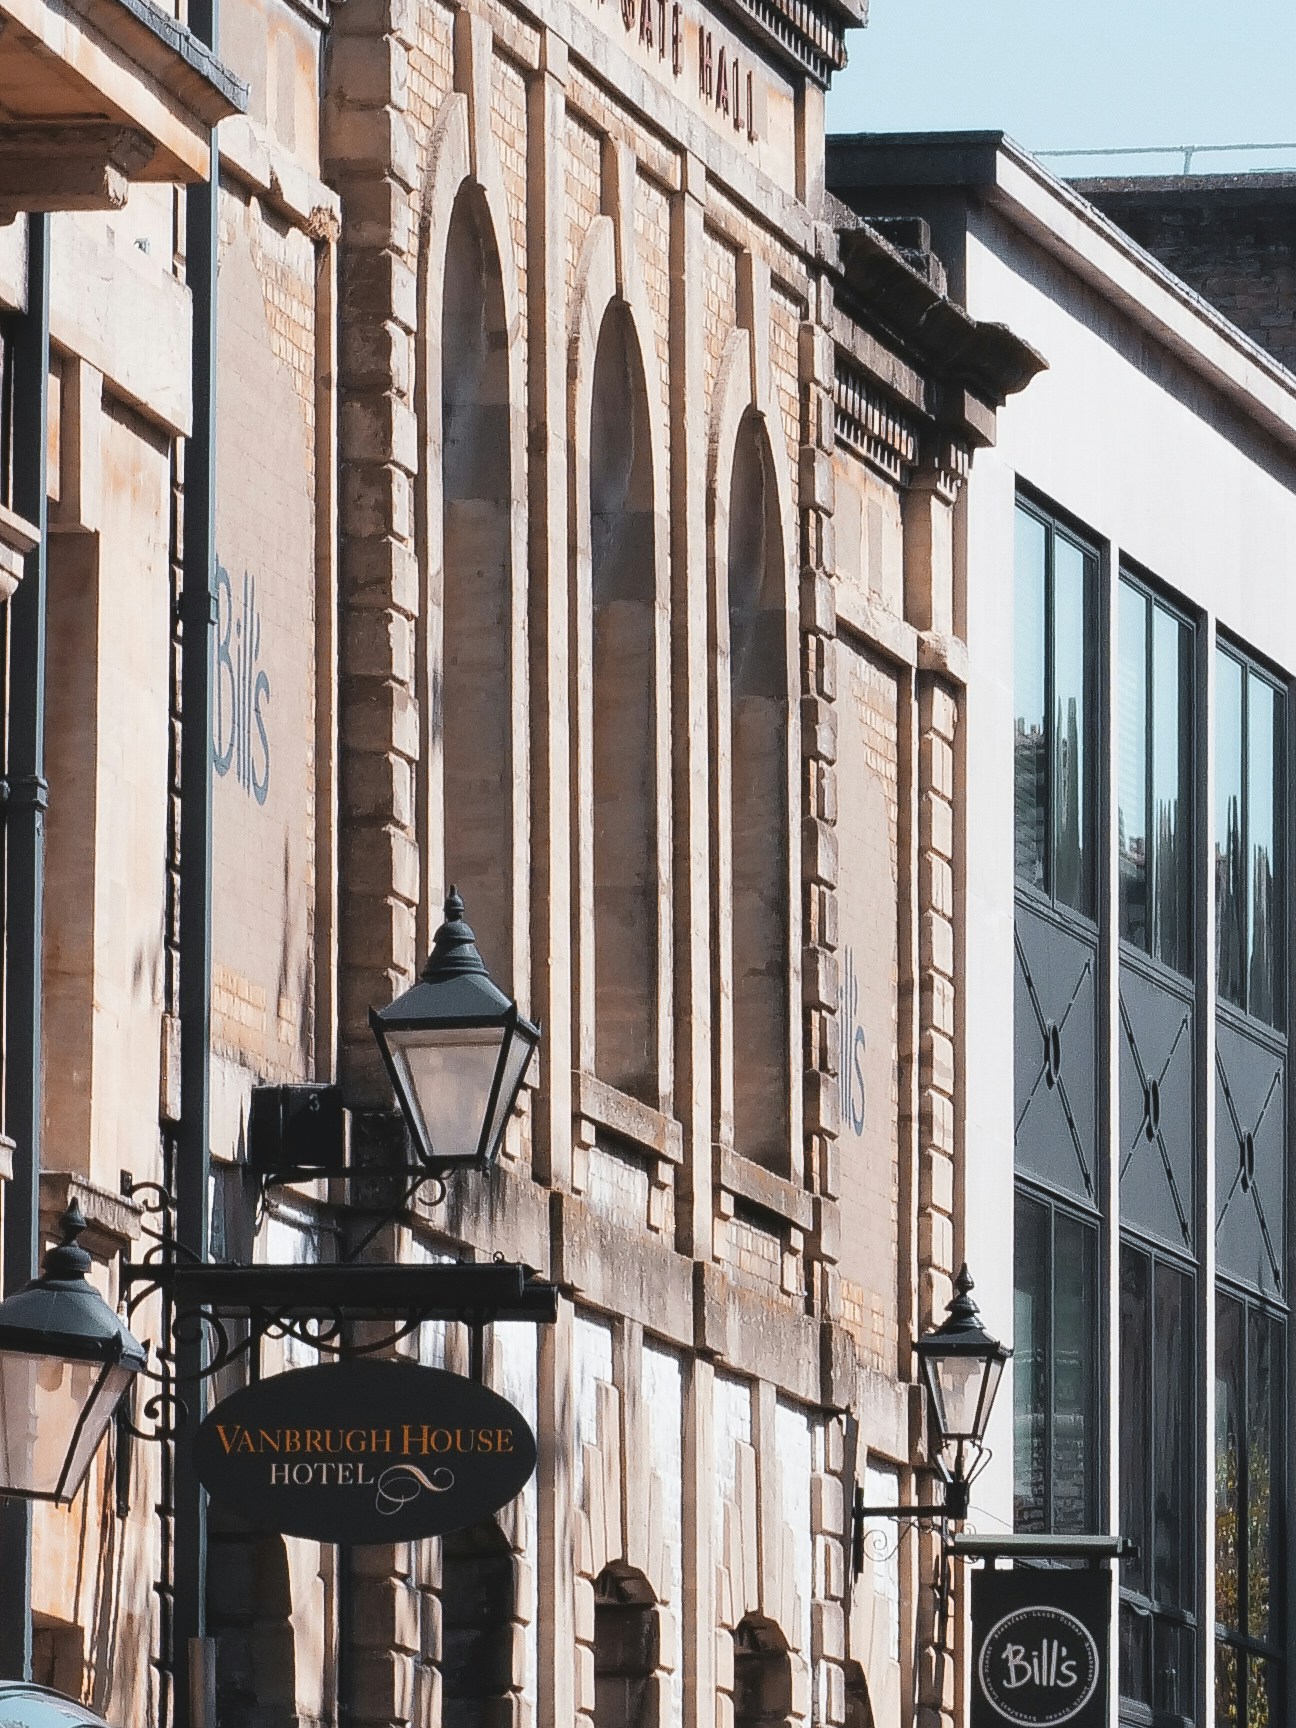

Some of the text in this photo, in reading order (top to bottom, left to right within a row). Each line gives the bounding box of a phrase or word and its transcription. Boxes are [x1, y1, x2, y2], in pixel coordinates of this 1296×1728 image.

[699, 24, 759, 145] HALL
[840, 944, 866, 1136] ill's
[401, 1424, 514, 1455] HOUSE
[269, 1463, 374, 1485] HOTEL
[1001, 1638, 1077, 1688] Bill's
